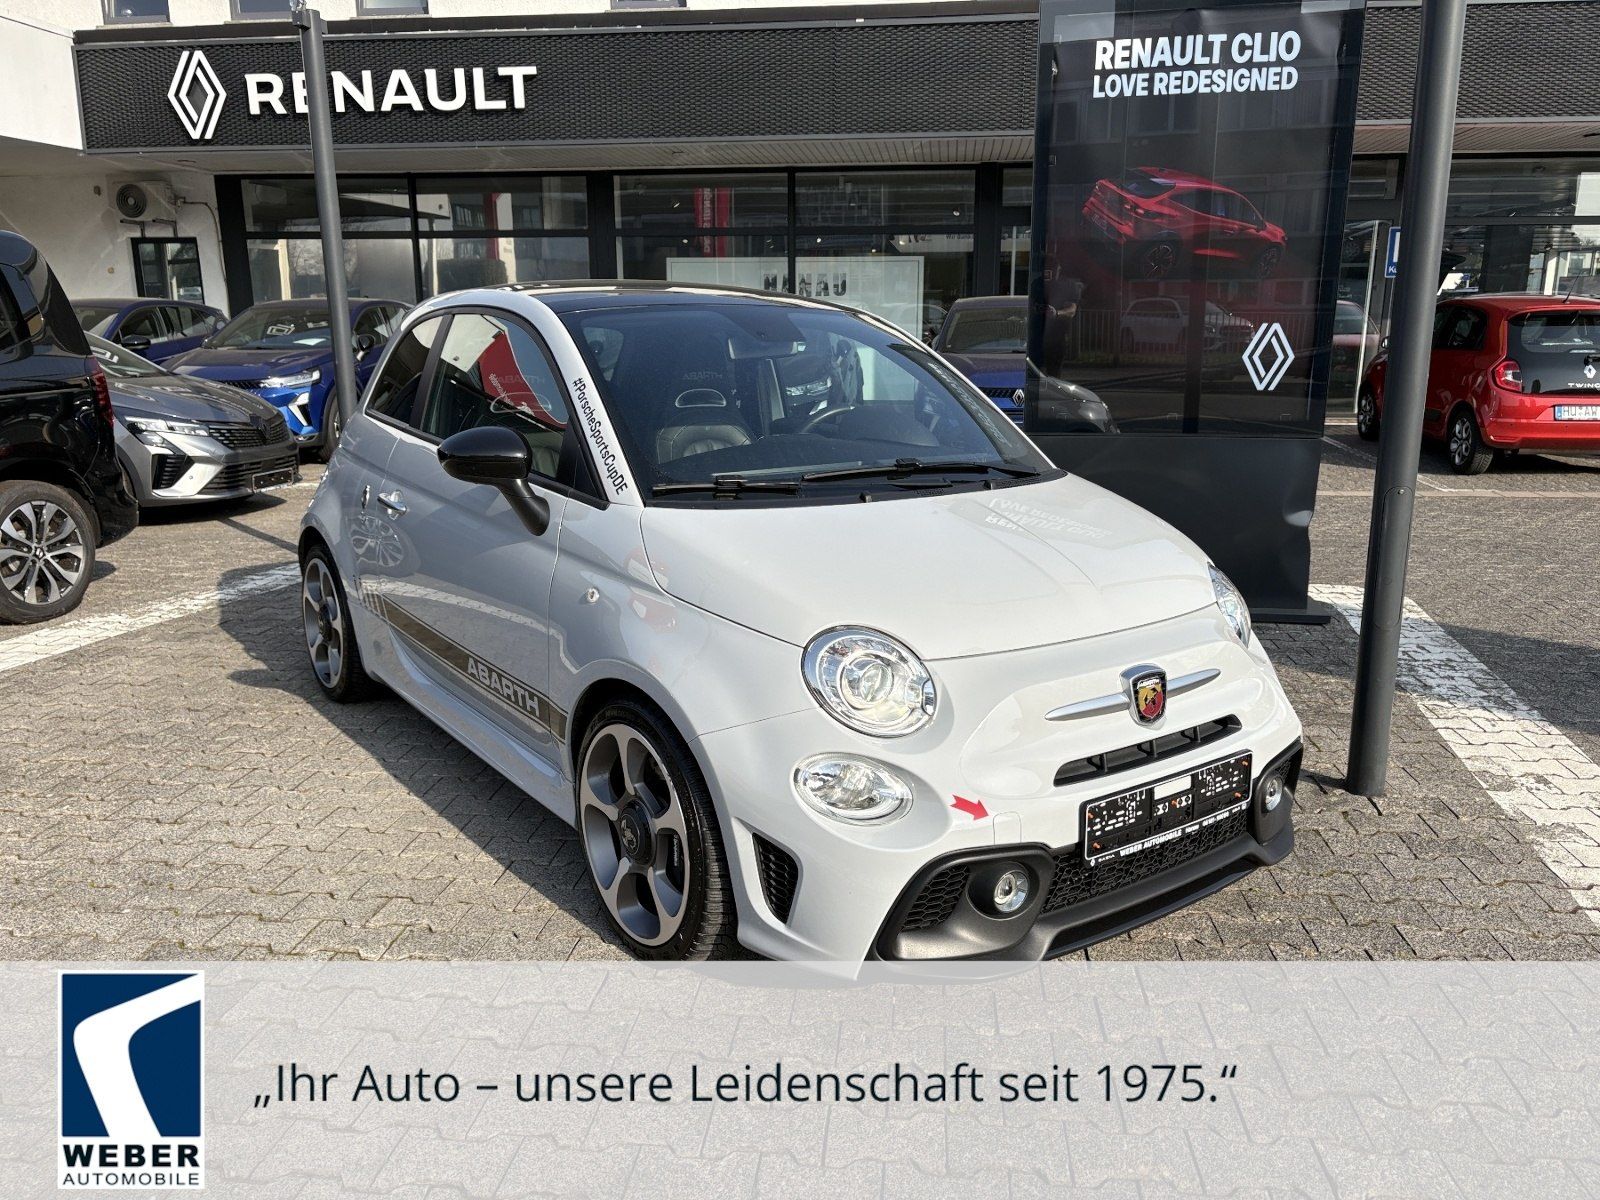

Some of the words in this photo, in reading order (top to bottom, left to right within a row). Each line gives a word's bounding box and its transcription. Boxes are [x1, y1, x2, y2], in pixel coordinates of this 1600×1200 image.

[1094, 33, 1228, 70] RENAULT
[1231, 30, 1302, 64] CLIO
[1092, 73, 1150, 98] LOVE
[1153, 66, 1299, 96] REDESIGNED
[572, 377, 629, 496] #PorscheSportsCupDE
[468, 656, 540, 718] ABARTH
[1119, 843, 1143, 857] WEBER
[1142, 828, 1183, 850] AUTOMOBILE
